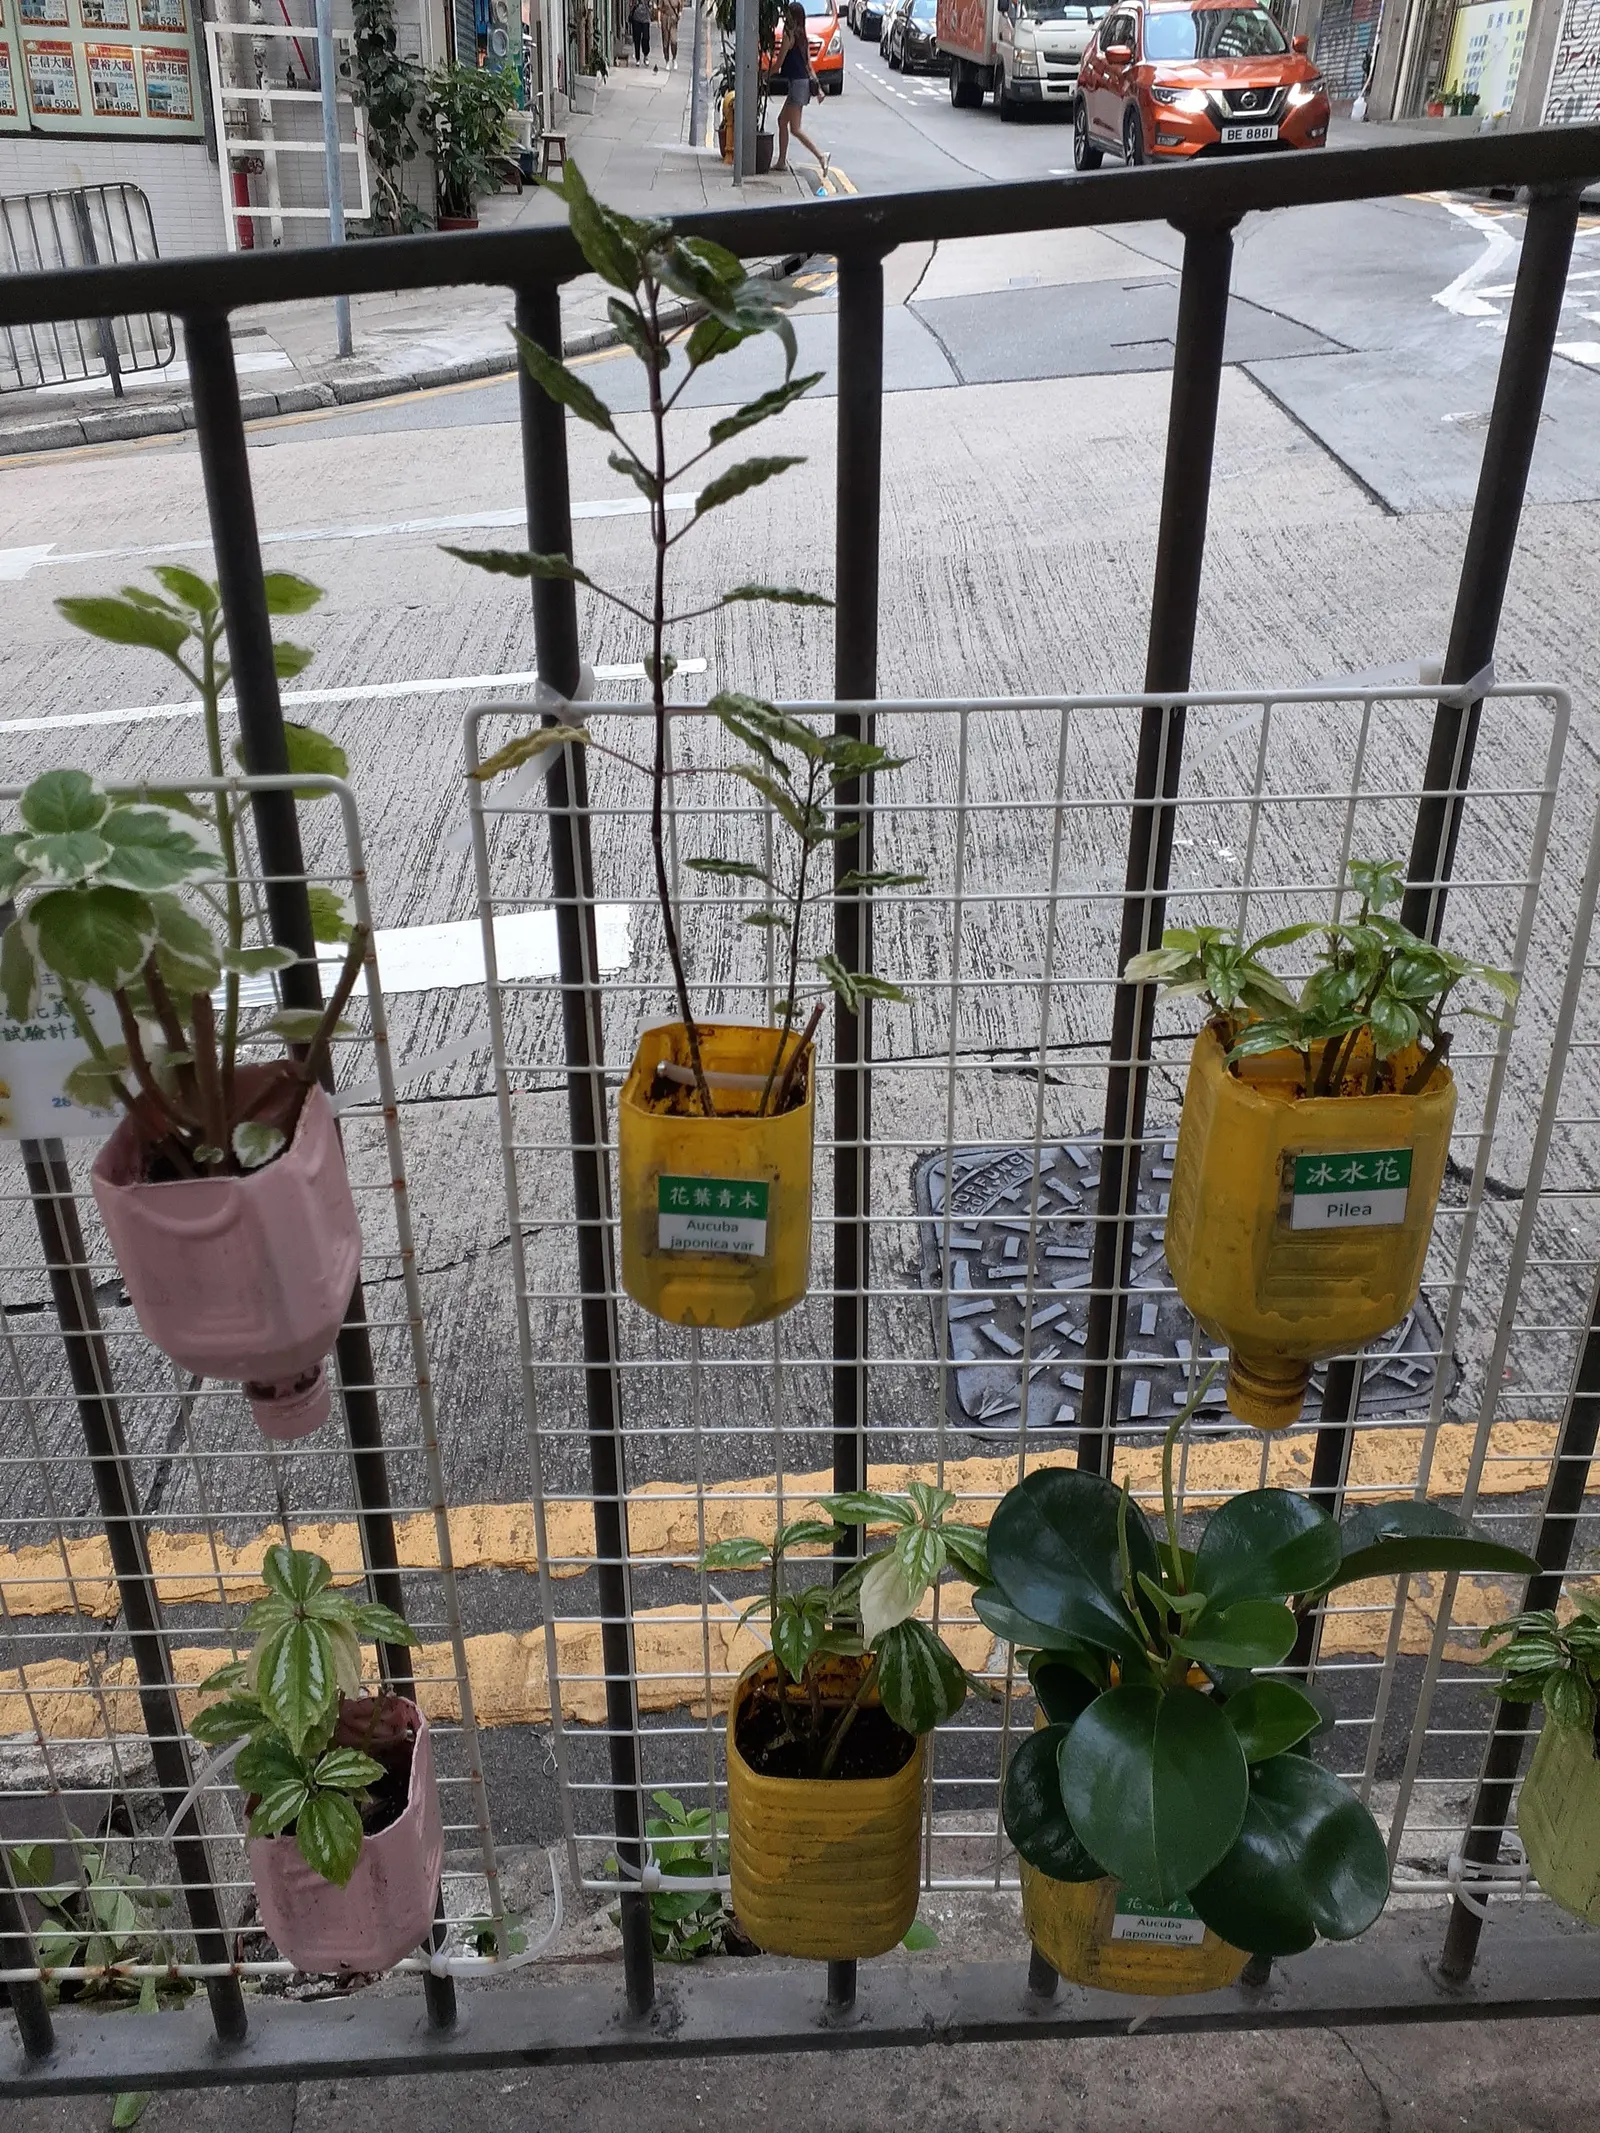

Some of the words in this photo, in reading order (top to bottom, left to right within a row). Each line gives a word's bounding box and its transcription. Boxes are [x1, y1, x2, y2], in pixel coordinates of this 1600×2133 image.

[28, 56, 73, 70] 仁信大廈
[90, 58, 133, 72] 豐裕大廈
[54, 99, 72, 109] 530
[114, 101, 132, 111] 498
[1227, 130, 1242, 140] BE
[1246, 128, 1272, 139] 8881
[1306, 1156, 1401, 1186] 冰水花
[670, 1186, 758, 1208] 花葉青木
[1326, 1202, 1372, 1218] Pilea
[686, 1219, 739, 1233] Aucuba
[670, 1235, 729, 1250] japonica
[733, 1240, 755, 1251] var
[1136, 1919, 1182, 1930] Aucuba
[1121, 1928, 1172, 1941] japonica
[1175, 1933, 1193, 1942] var
